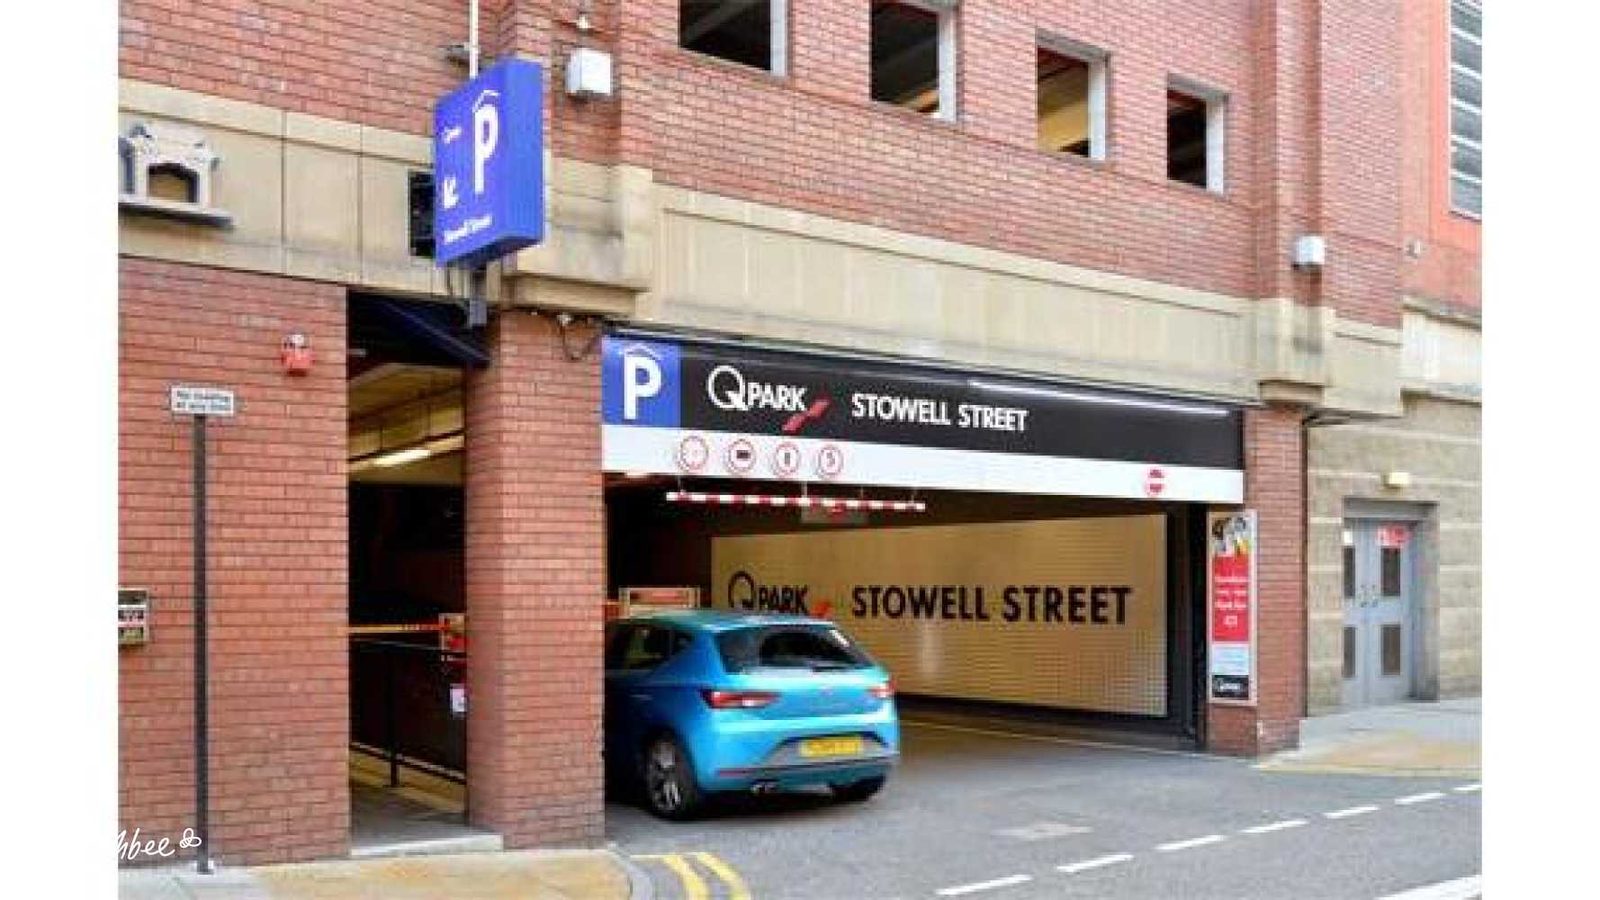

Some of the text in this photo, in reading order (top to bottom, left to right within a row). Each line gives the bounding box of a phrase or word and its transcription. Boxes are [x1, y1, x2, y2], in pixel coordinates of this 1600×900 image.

[473, 102, 499, 195] P
[623, 355, 662, 421] P
[851, 392, 951, 426] STOWELL
[958, 404, 1029, 433] STREET
[851, 584, 990, 622] STOWELL
[1003, 584, 1133, 625] STREET
